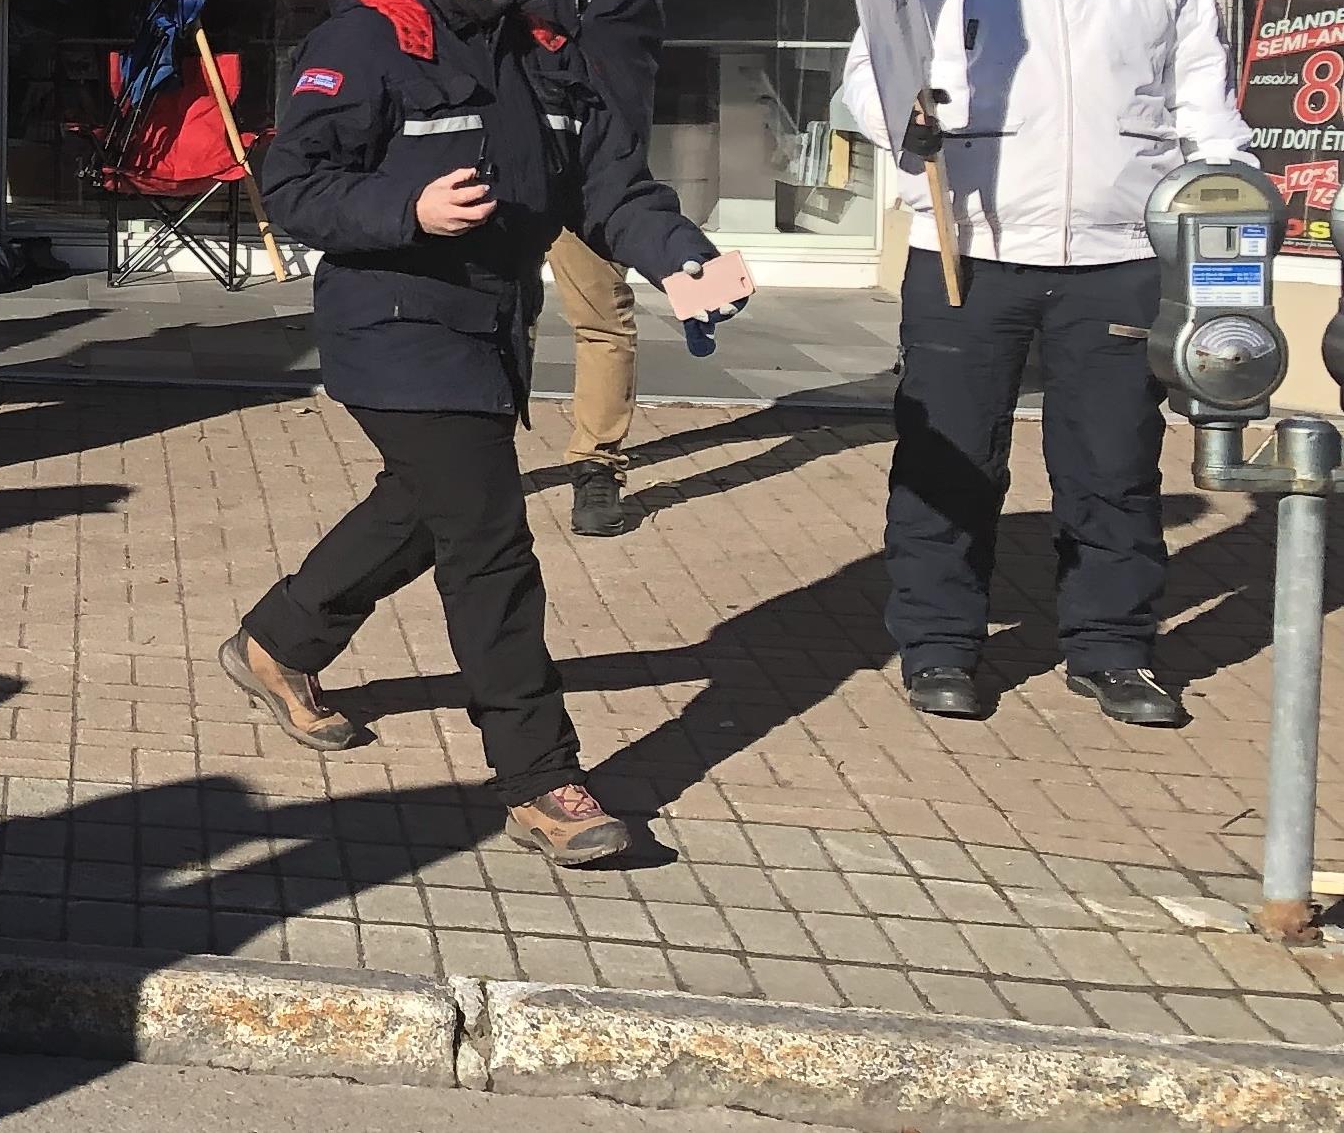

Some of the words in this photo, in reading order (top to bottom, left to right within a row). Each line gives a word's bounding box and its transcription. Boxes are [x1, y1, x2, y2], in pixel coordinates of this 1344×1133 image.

[1293, 51, 1344, 125] 8
[1250, 128, 1283, 149] OUT
[1282, 128, 1322, 150] DOIT
[1322, 124, 1344, 152] ÊT
